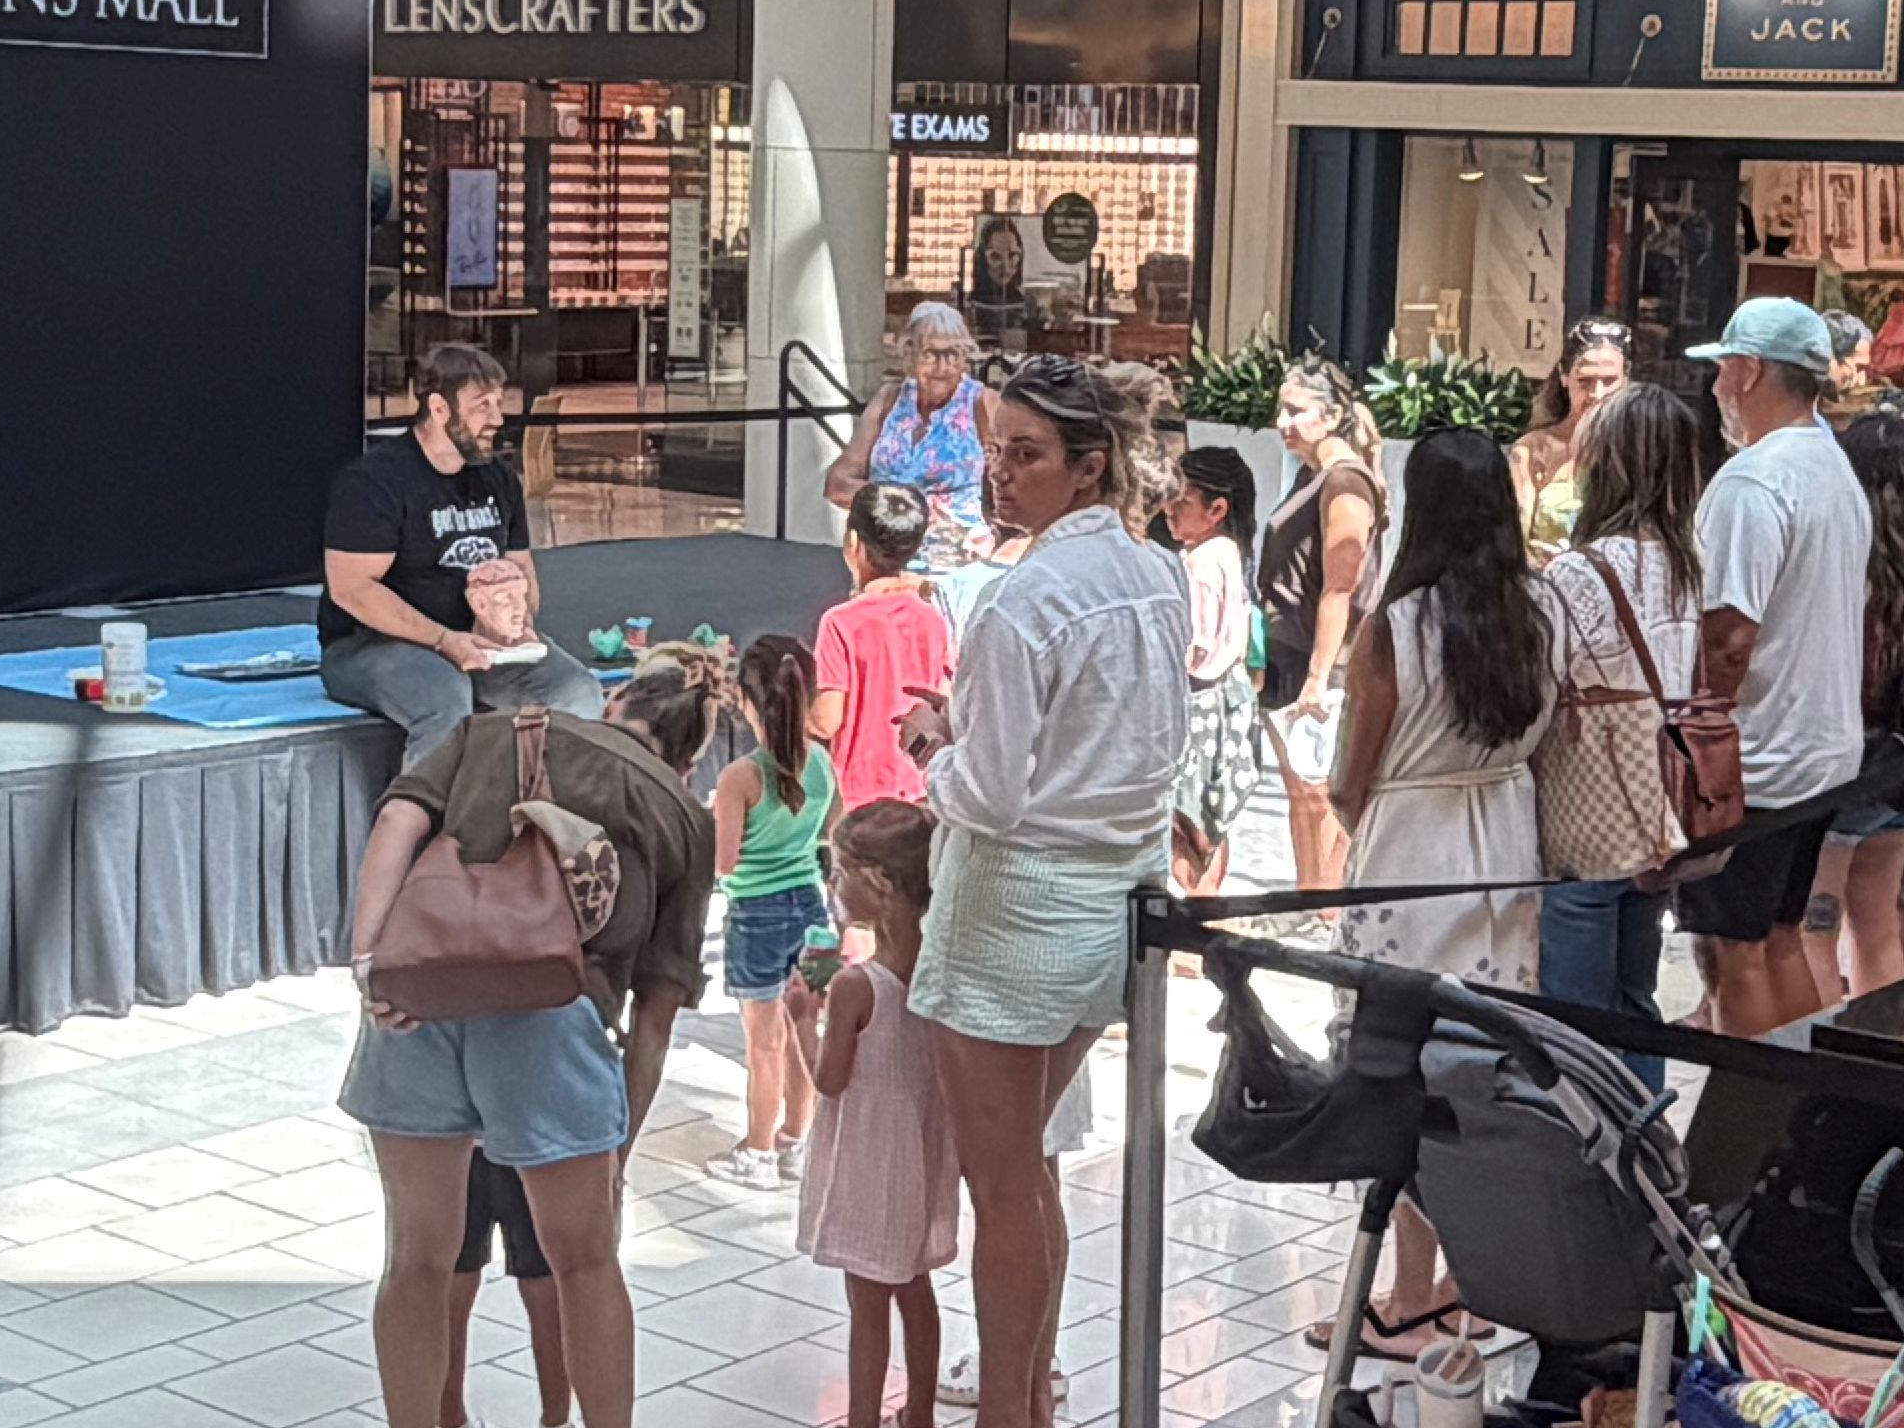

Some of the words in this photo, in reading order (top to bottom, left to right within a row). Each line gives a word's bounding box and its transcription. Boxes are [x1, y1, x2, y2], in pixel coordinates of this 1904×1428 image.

[1750, 17, 1853, 42] JACK
[889, 112, 907, 141] E
[911, 113, 991, 142] EXAMS
